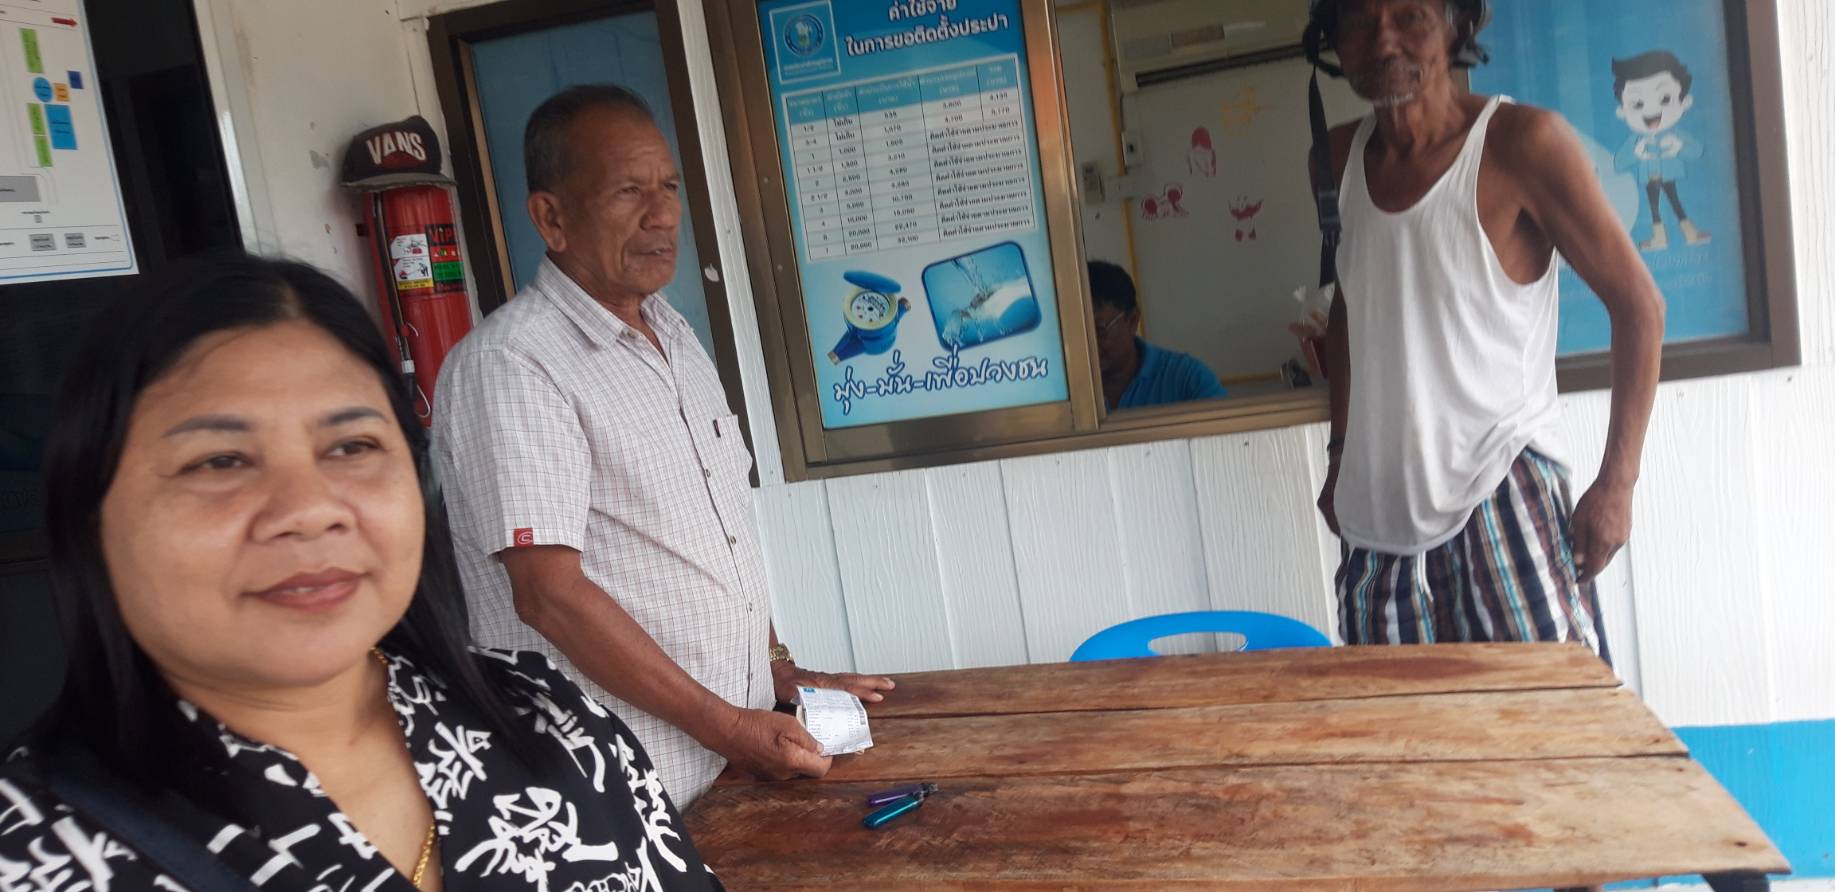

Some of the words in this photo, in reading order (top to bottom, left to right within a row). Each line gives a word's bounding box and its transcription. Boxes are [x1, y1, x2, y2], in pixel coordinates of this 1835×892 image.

[889, 0, 957, 21] ค่าใชจาย
[845, 12, 1009, 57] ในการขอติดตั้งประปา
[366, 131, 427, 166] VANS
[833, 345, 1049, 416] มุ่ง-มั่น-เพื่อปวงชน
